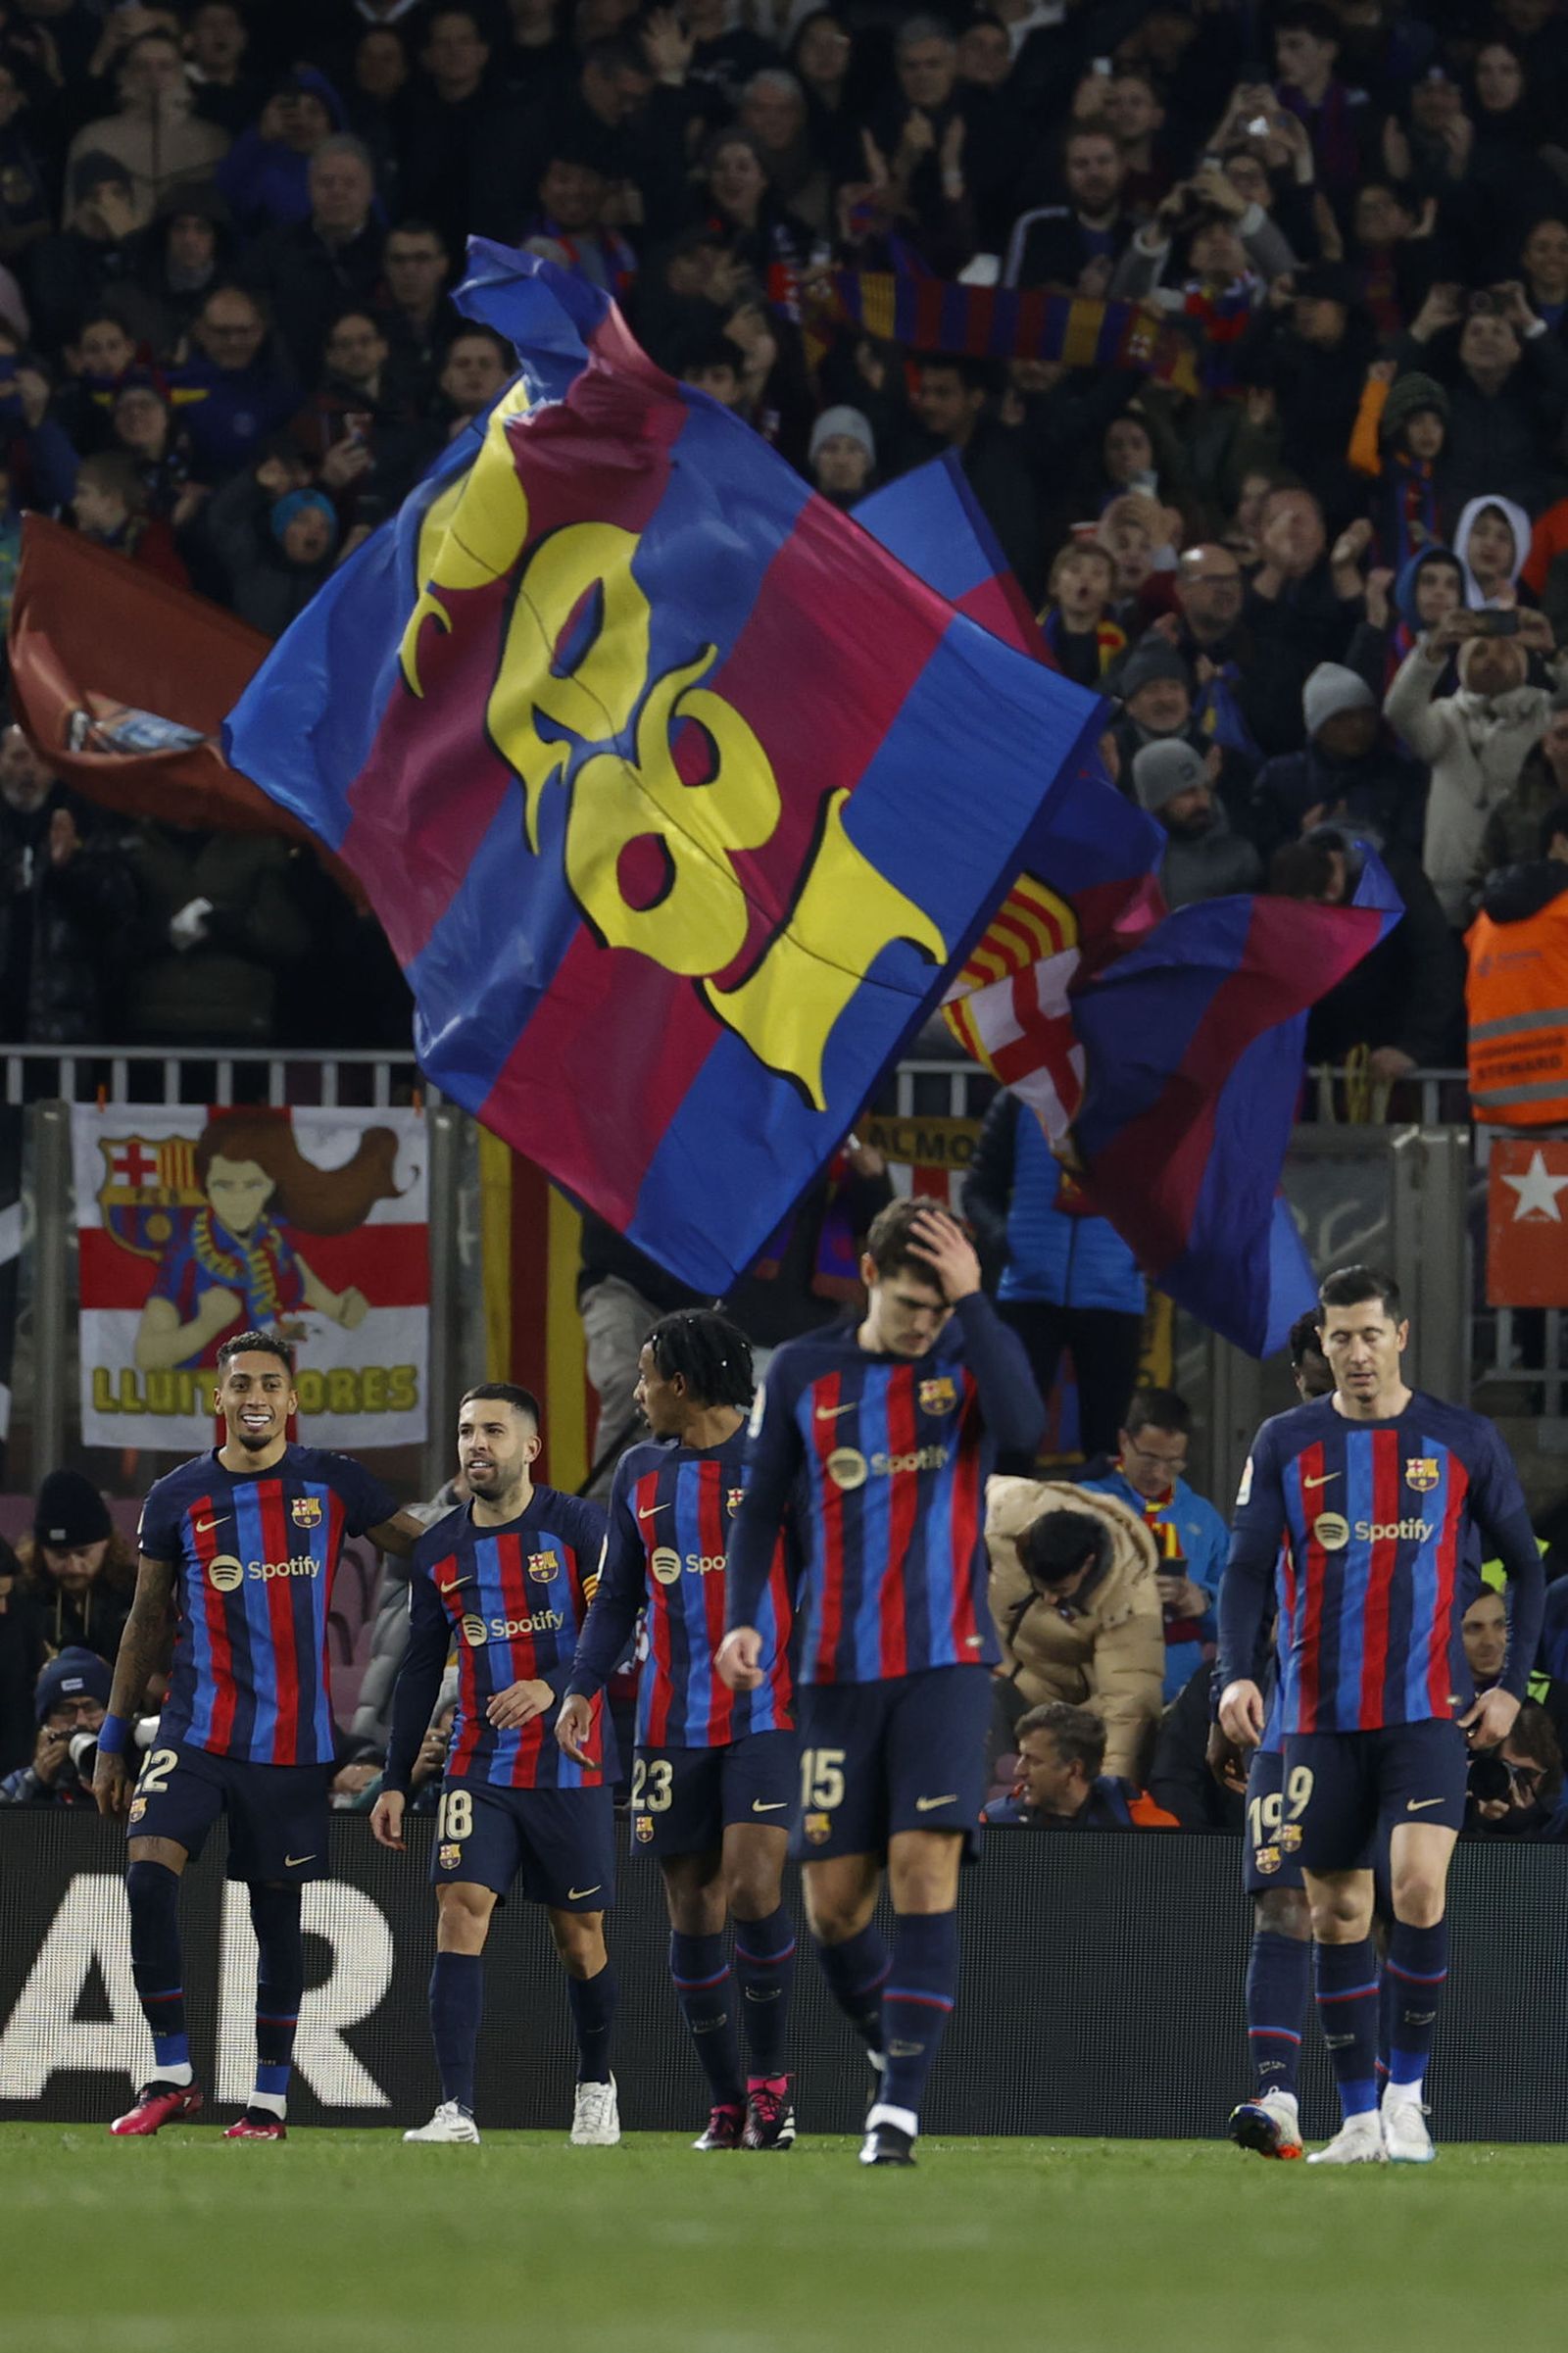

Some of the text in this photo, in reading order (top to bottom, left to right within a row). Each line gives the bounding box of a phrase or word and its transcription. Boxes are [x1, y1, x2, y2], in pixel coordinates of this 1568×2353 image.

[91, 1366, 417, 1413] LLUITORES
[1354, 1518, 1434, 1543] Spotify
[247, 1555, 320, 1582] Spotify
[685, 1553, 729, 1576] Spo
[490, 1609, 564, 1639] Spotify
[631, 1759, 673, 1812] 23
[800, 1748, 846, 1810] 15
[1287, 1766, 1314, 1821] 9
[437, 1789, 472, 1841] 18
